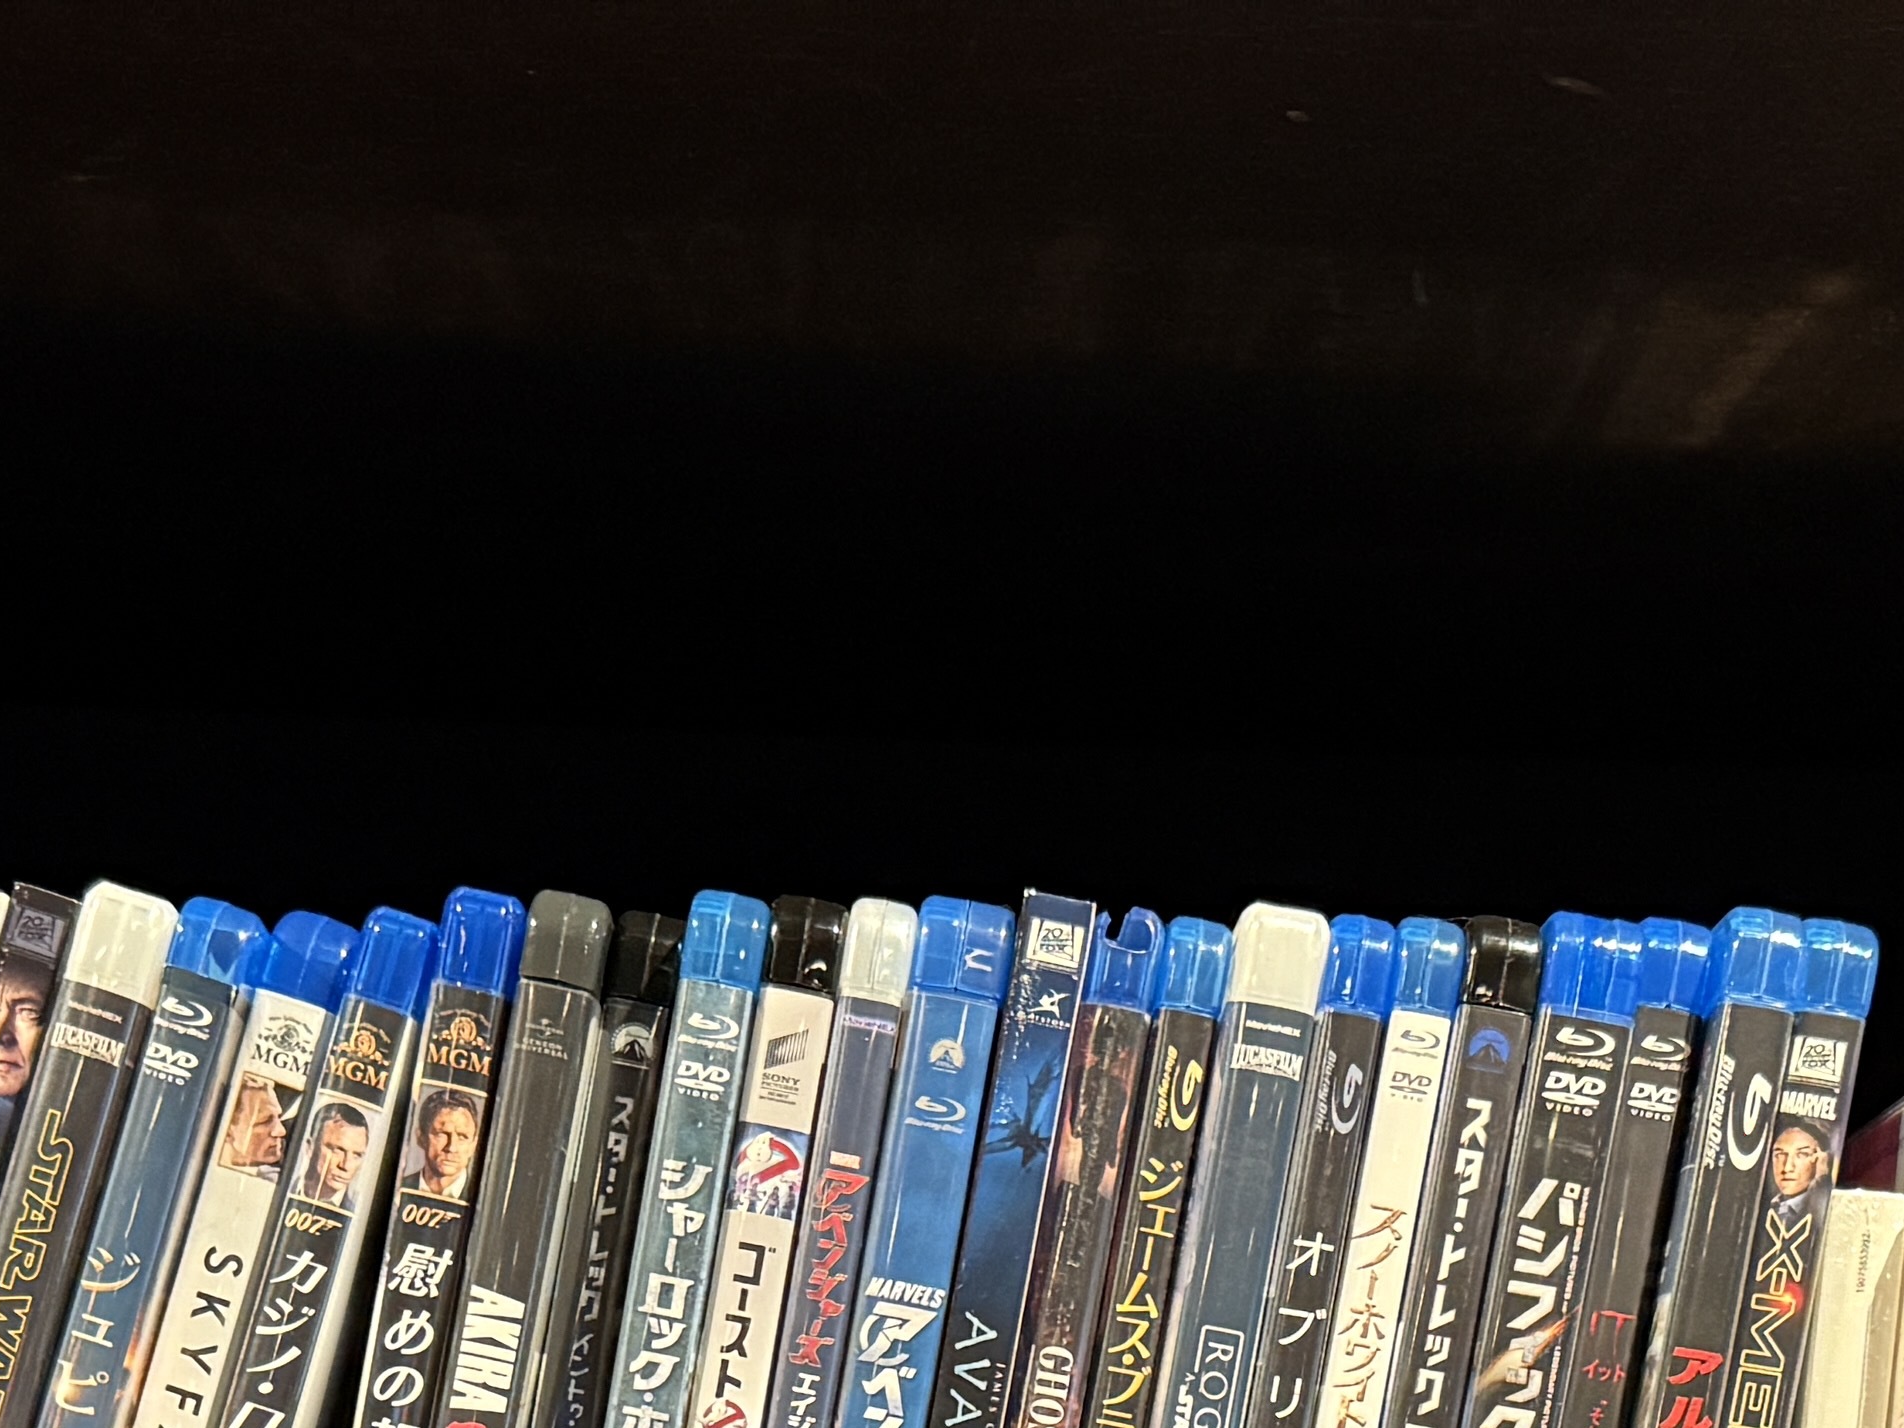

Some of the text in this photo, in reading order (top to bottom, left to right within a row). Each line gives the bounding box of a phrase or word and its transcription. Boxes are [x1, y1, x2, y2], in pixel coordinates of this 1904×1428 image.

[251, 1044, 310, 1076] MGM
[1780, 1090, 1838, 1120] MARVEL
[0, 1110, 74, 1290] STAR
[449, 1284, 526, 1415] AKIRA
